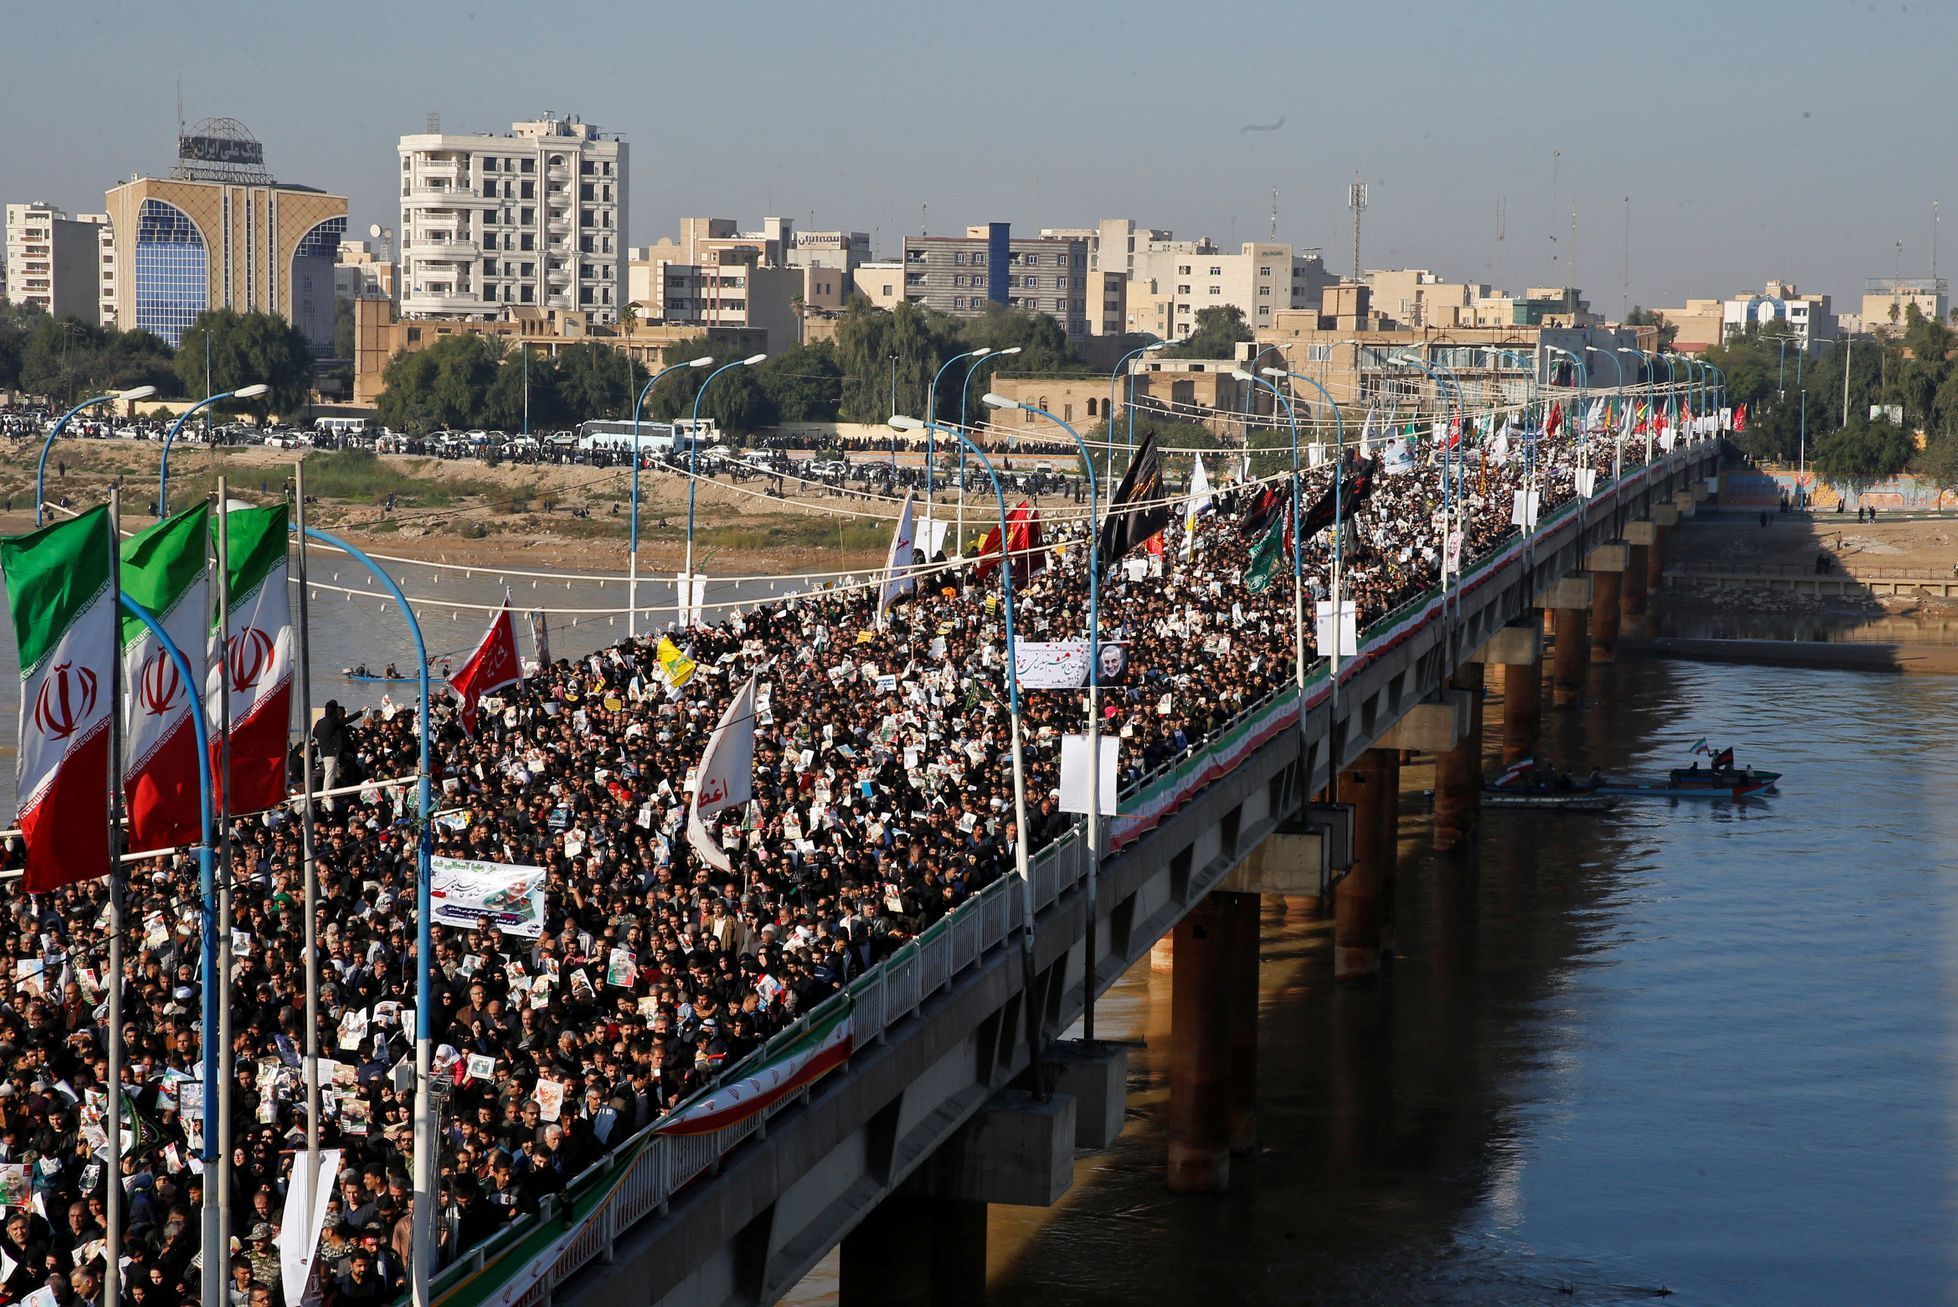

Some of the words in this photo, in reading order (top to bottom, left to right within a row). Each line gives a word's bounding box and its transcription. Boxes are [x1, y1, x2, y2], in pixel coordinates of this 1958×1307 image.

[195, 140, 219, 159] ایران
[220, 141, 239, 159] ملی
[241, 142, 262, 158] بانک
[798, 235, 819, 246] ایران
[819, 235, 840, 246] بیمه
